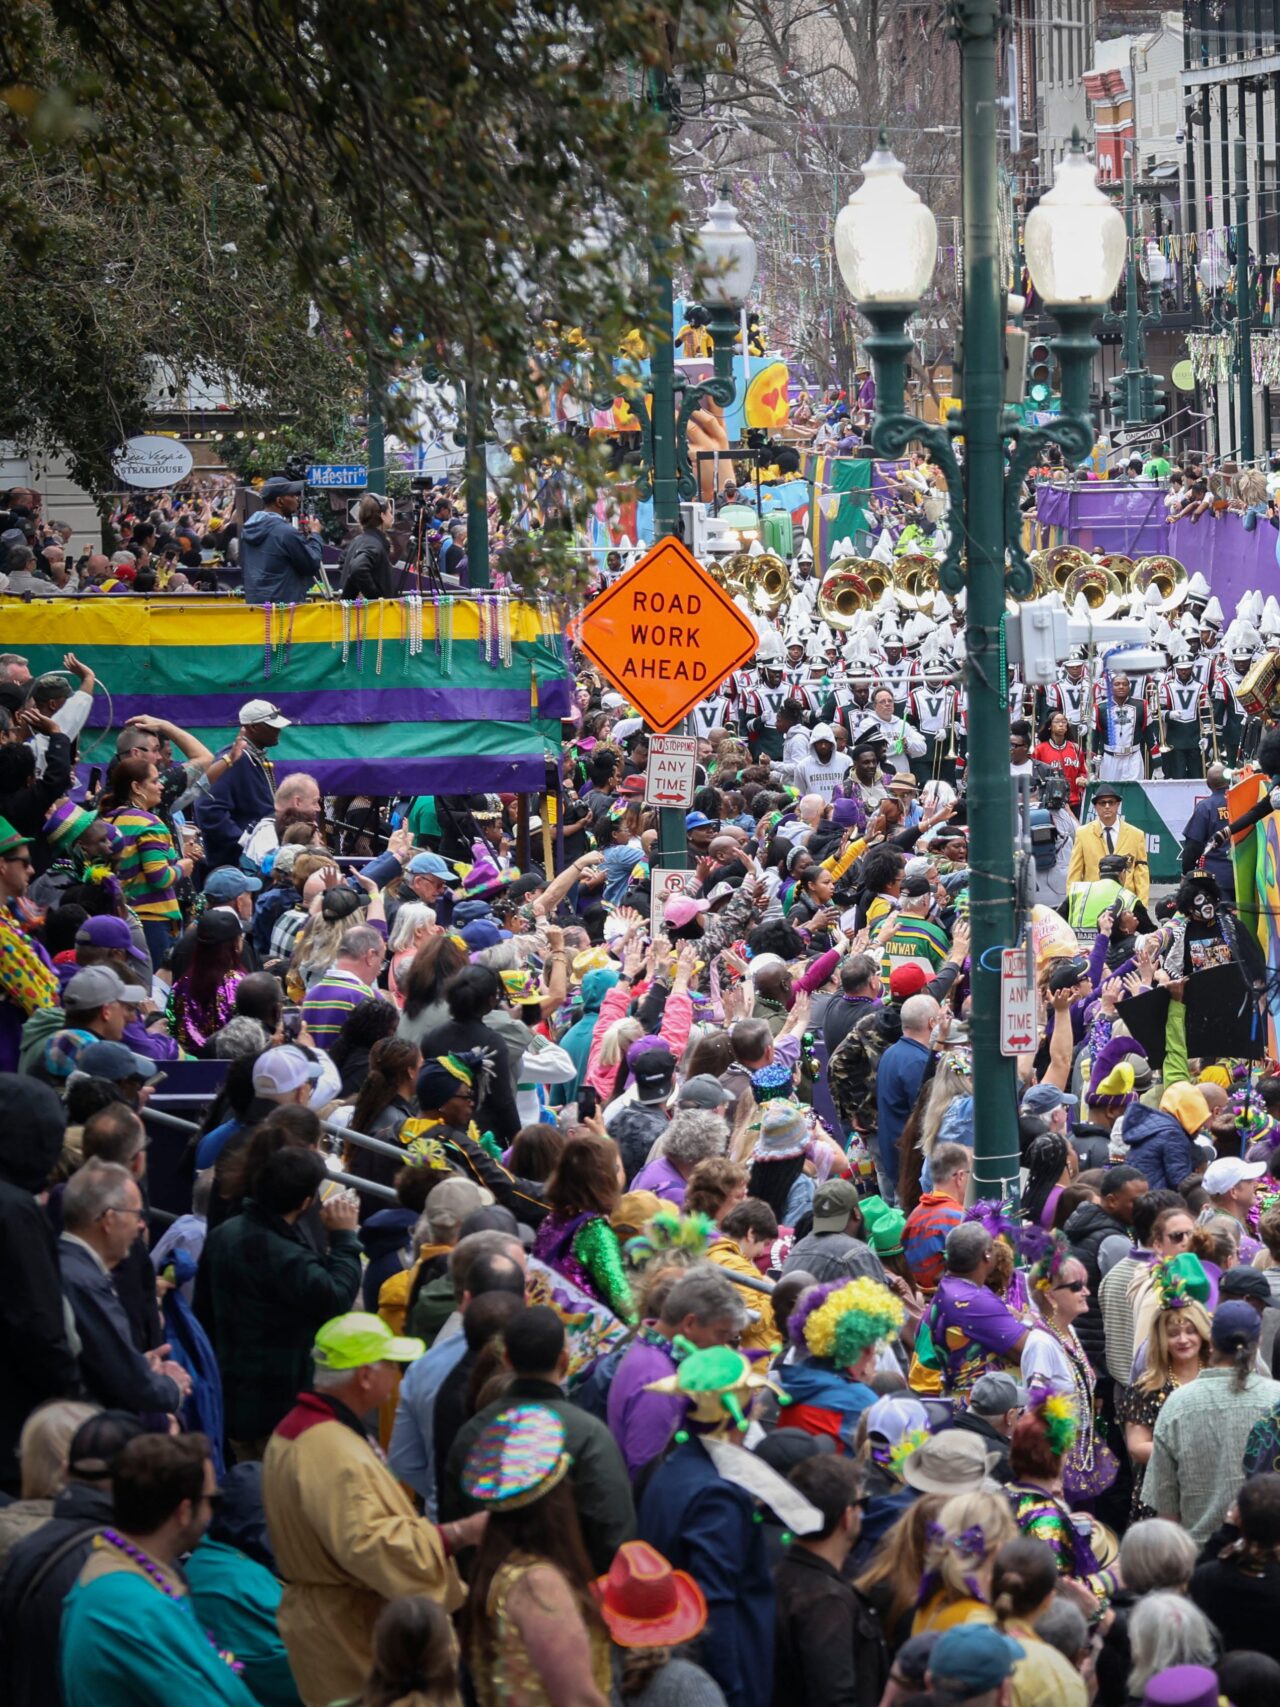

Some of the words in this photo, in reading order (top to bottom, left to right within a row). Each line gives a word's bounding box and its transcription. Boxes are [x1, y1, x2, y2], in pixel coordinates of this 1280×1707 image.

[120, 465, 184, 474] STEAKHOUSE
[312, 466, 358, 485] Maestri
[633, 591, 702, 615] ROAD
[631, 624, 700, 648] WORK
[622, 657, 707, 682] AHEAD
[765, 693, 785, 713] V
[925, 697, 944, 717] V
[1176, 689, 1195, 710] V
[699, 707, 718, 727] V
[652, 737, 664, 752] NO
[658, 759, 686, 772] ANY
[655, 777, 687, 791] TIME
[886, 941, 917, 956] ONWAY
[1009, 986, 1029, 1003] ANY
[1008, 1013, 1032, 1030] TIME
